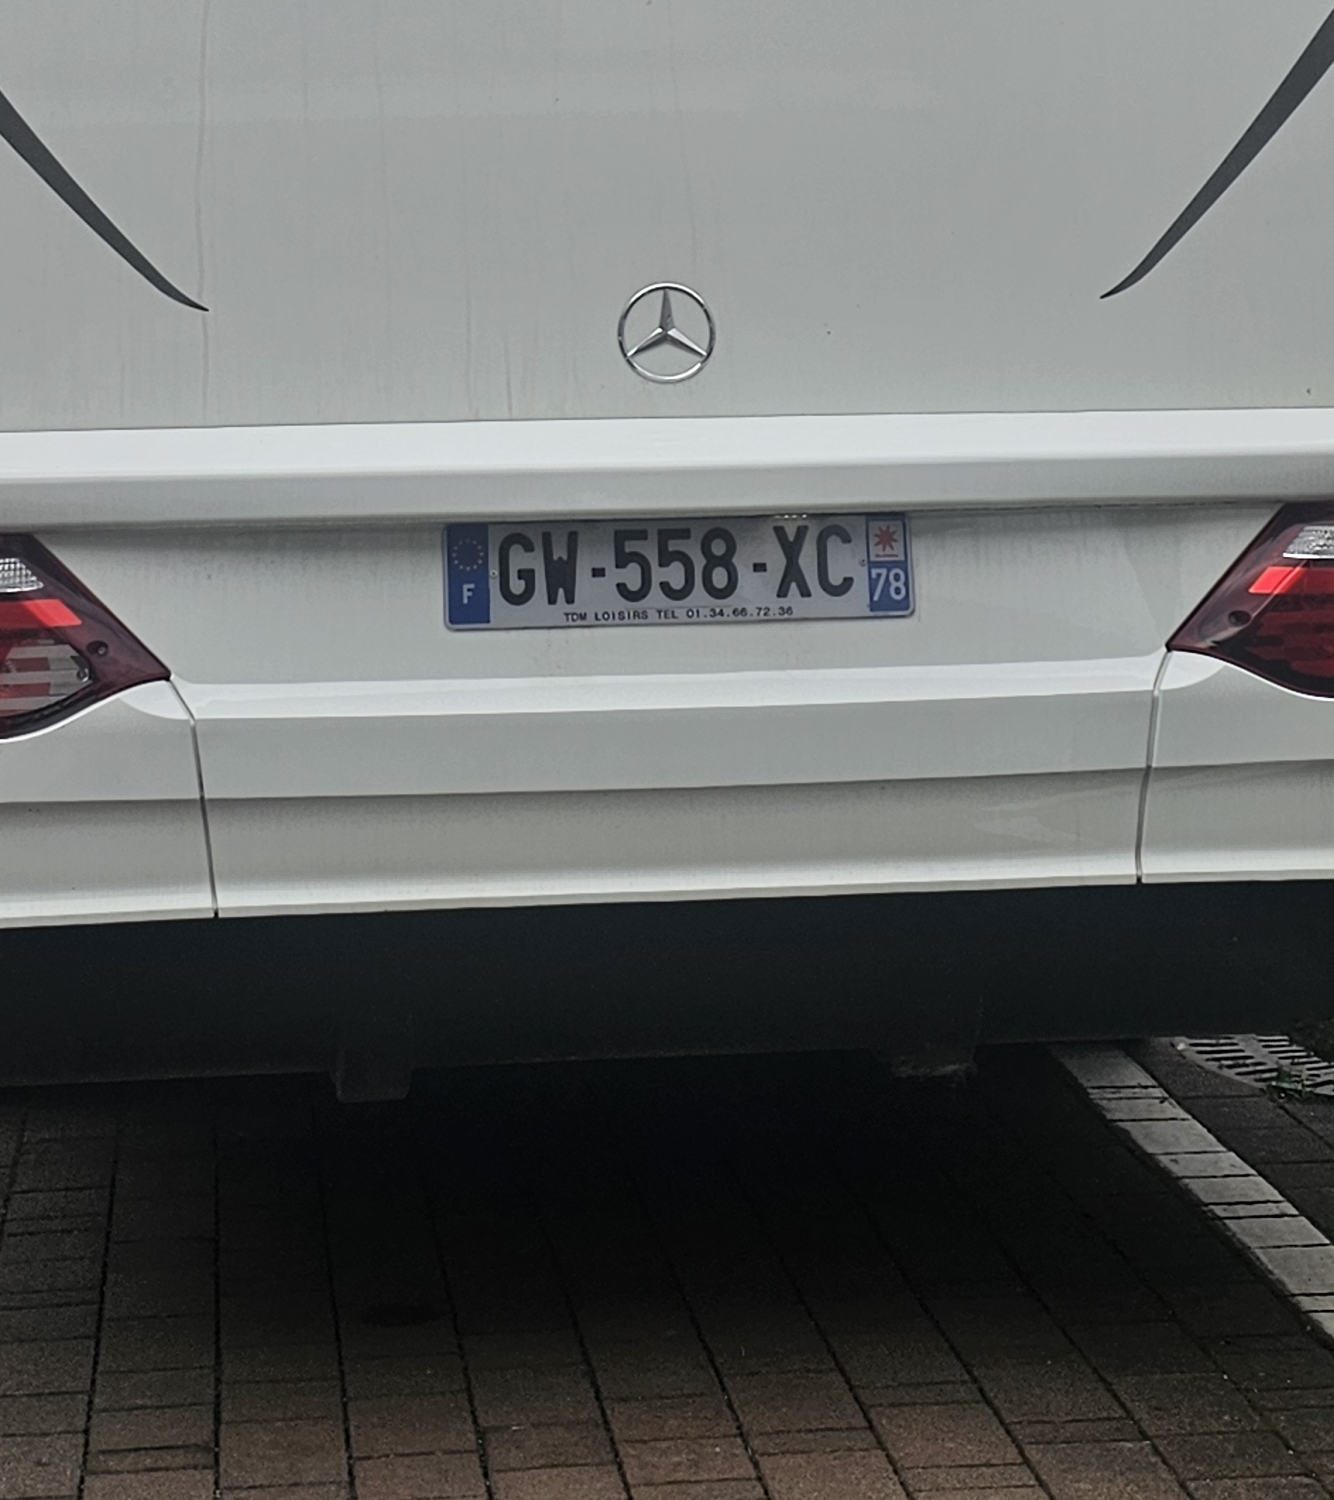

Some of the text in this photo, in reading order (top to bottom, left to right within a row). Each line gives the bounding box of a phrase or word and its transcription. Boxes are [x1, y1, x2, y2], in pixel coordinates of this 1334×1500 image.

[498, 524, 854, 606] GW-558-XC
[462, 583, 475, 604] F
[871, 567, 906, 602] 78
[564, 606, 794, 622] TDM LOISIRS TEL 01.34.66.72.36
